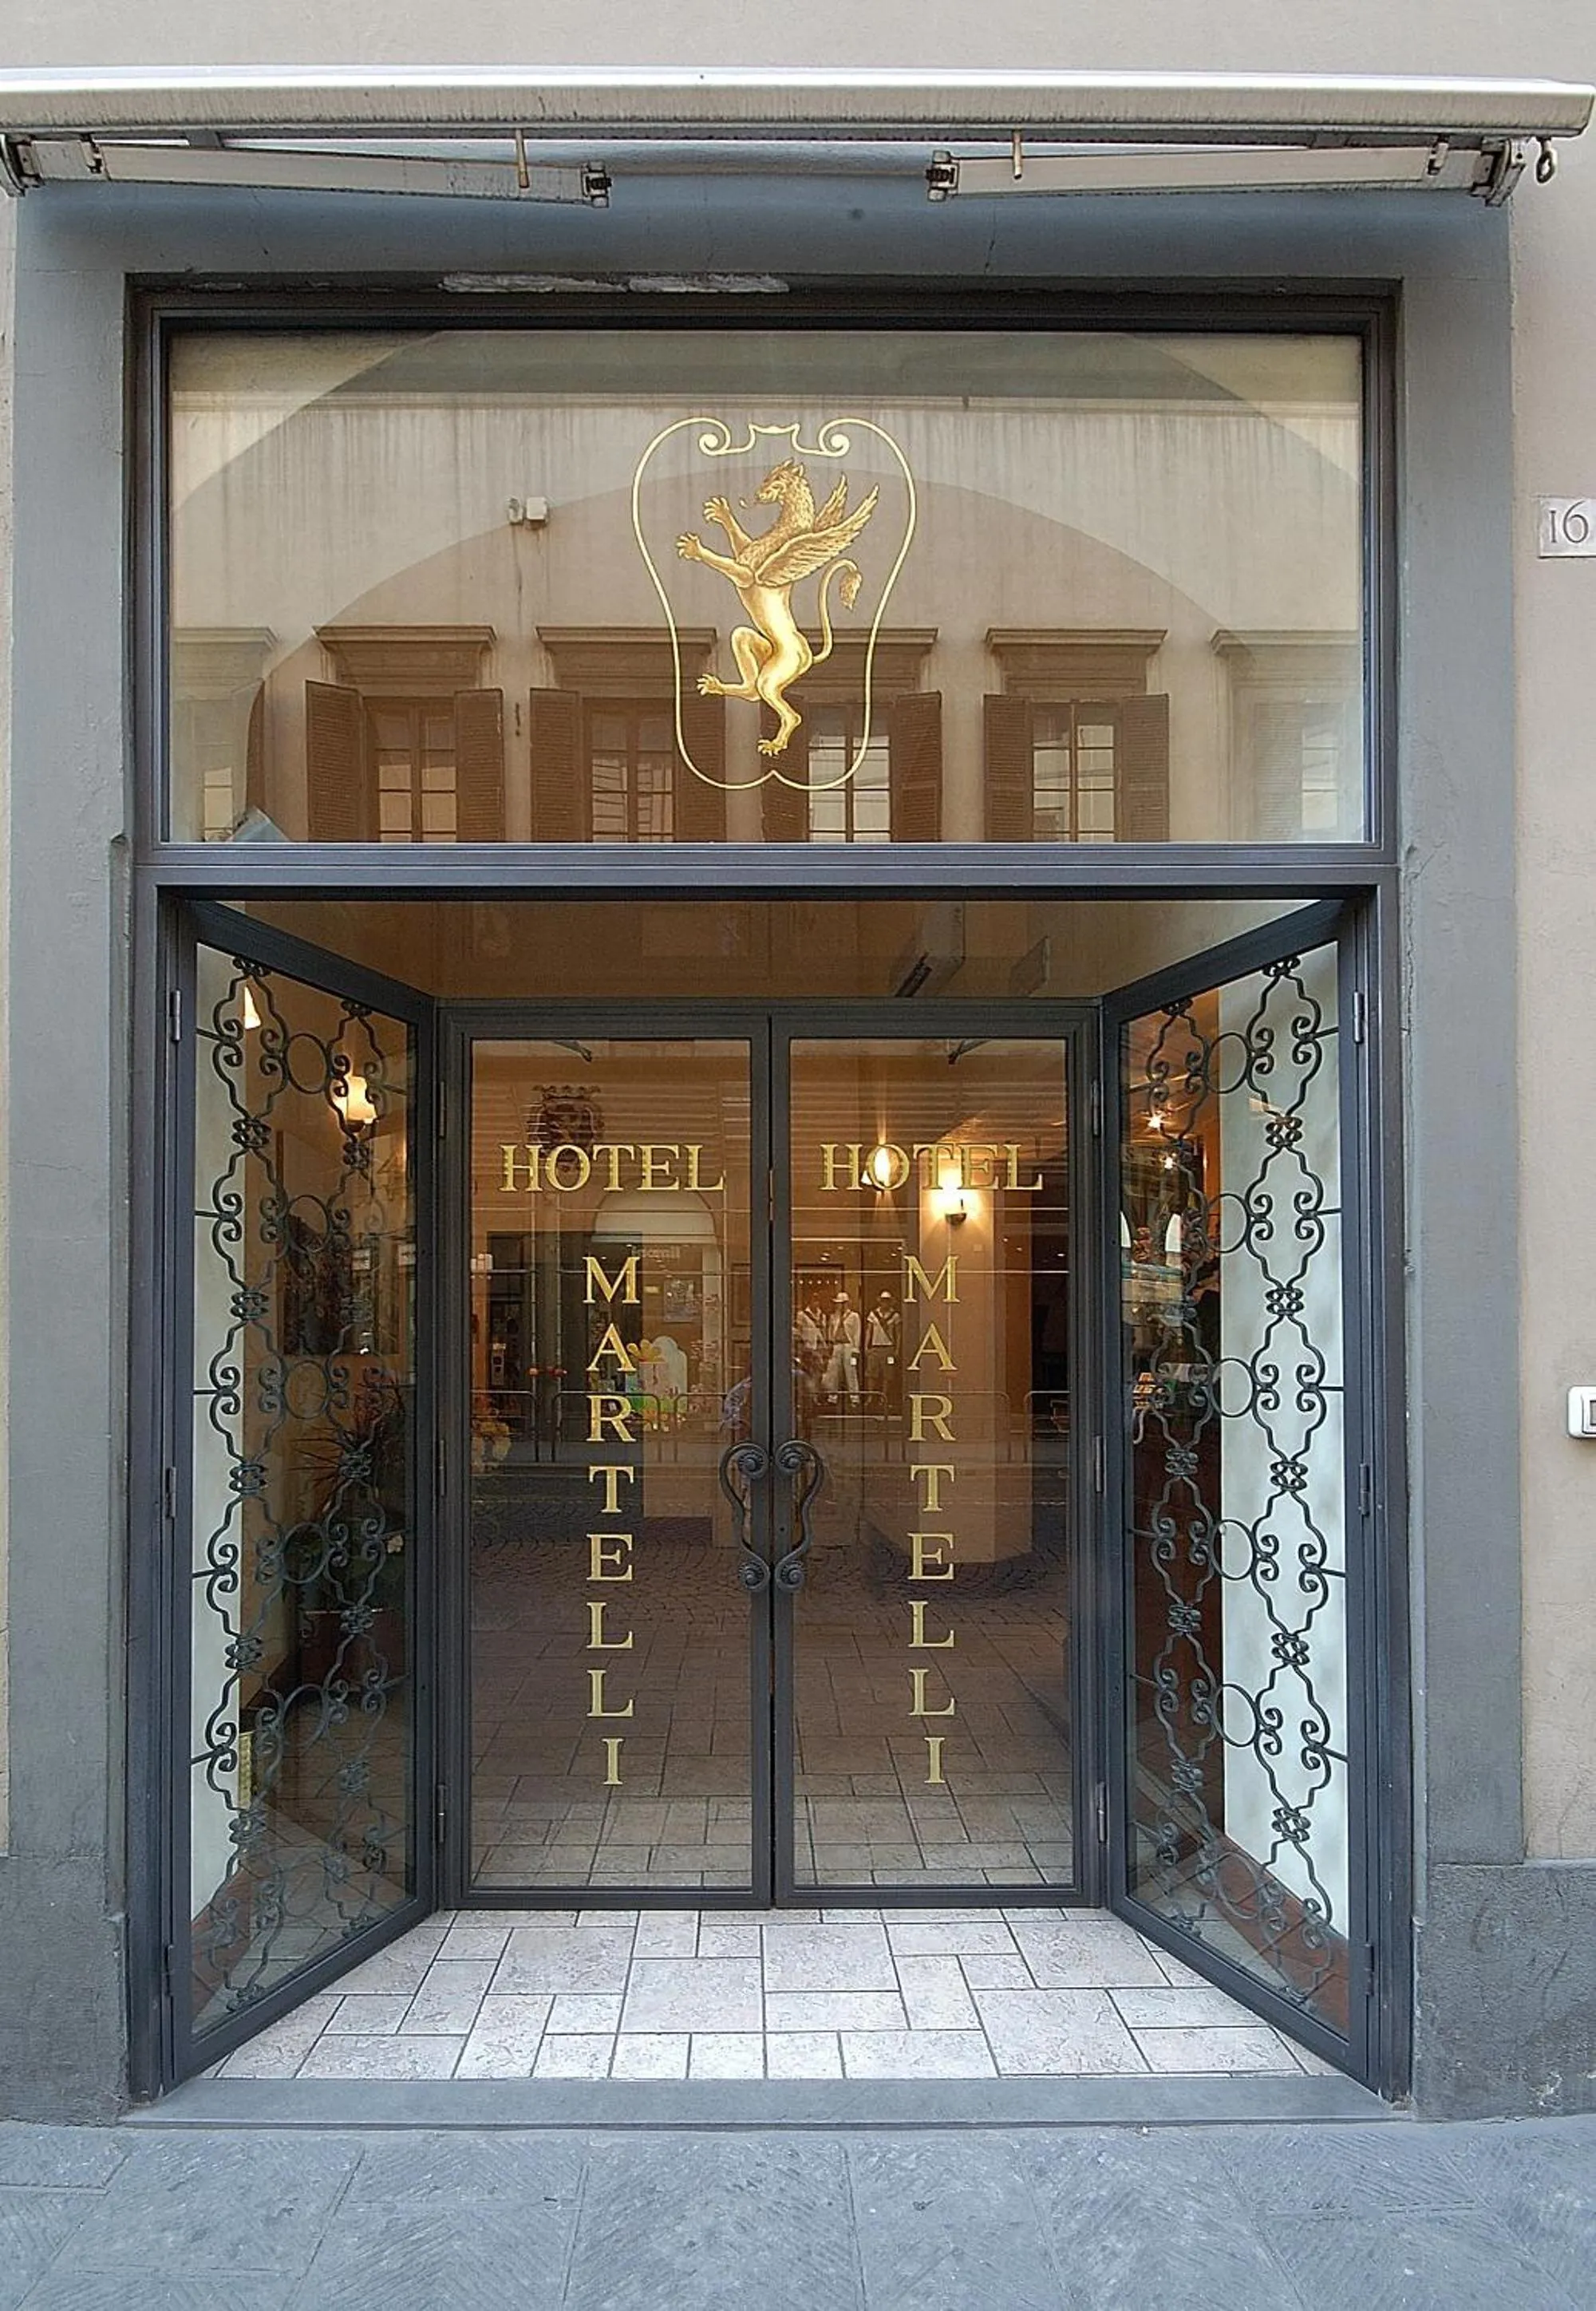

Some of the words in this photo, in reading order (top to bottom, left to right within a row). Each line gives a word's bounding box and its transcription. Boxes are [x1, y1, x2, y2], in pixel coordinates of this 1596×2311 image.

[1549, 500, 1589, 543] 16
[499, 1143, 726, 1192] HOTEL
[820, 1143, 1044, 1191] HOTEL
[582, 1255, 640, 1785] MARTELLI
[903, 1254, 960, 1784] MARTELLI
